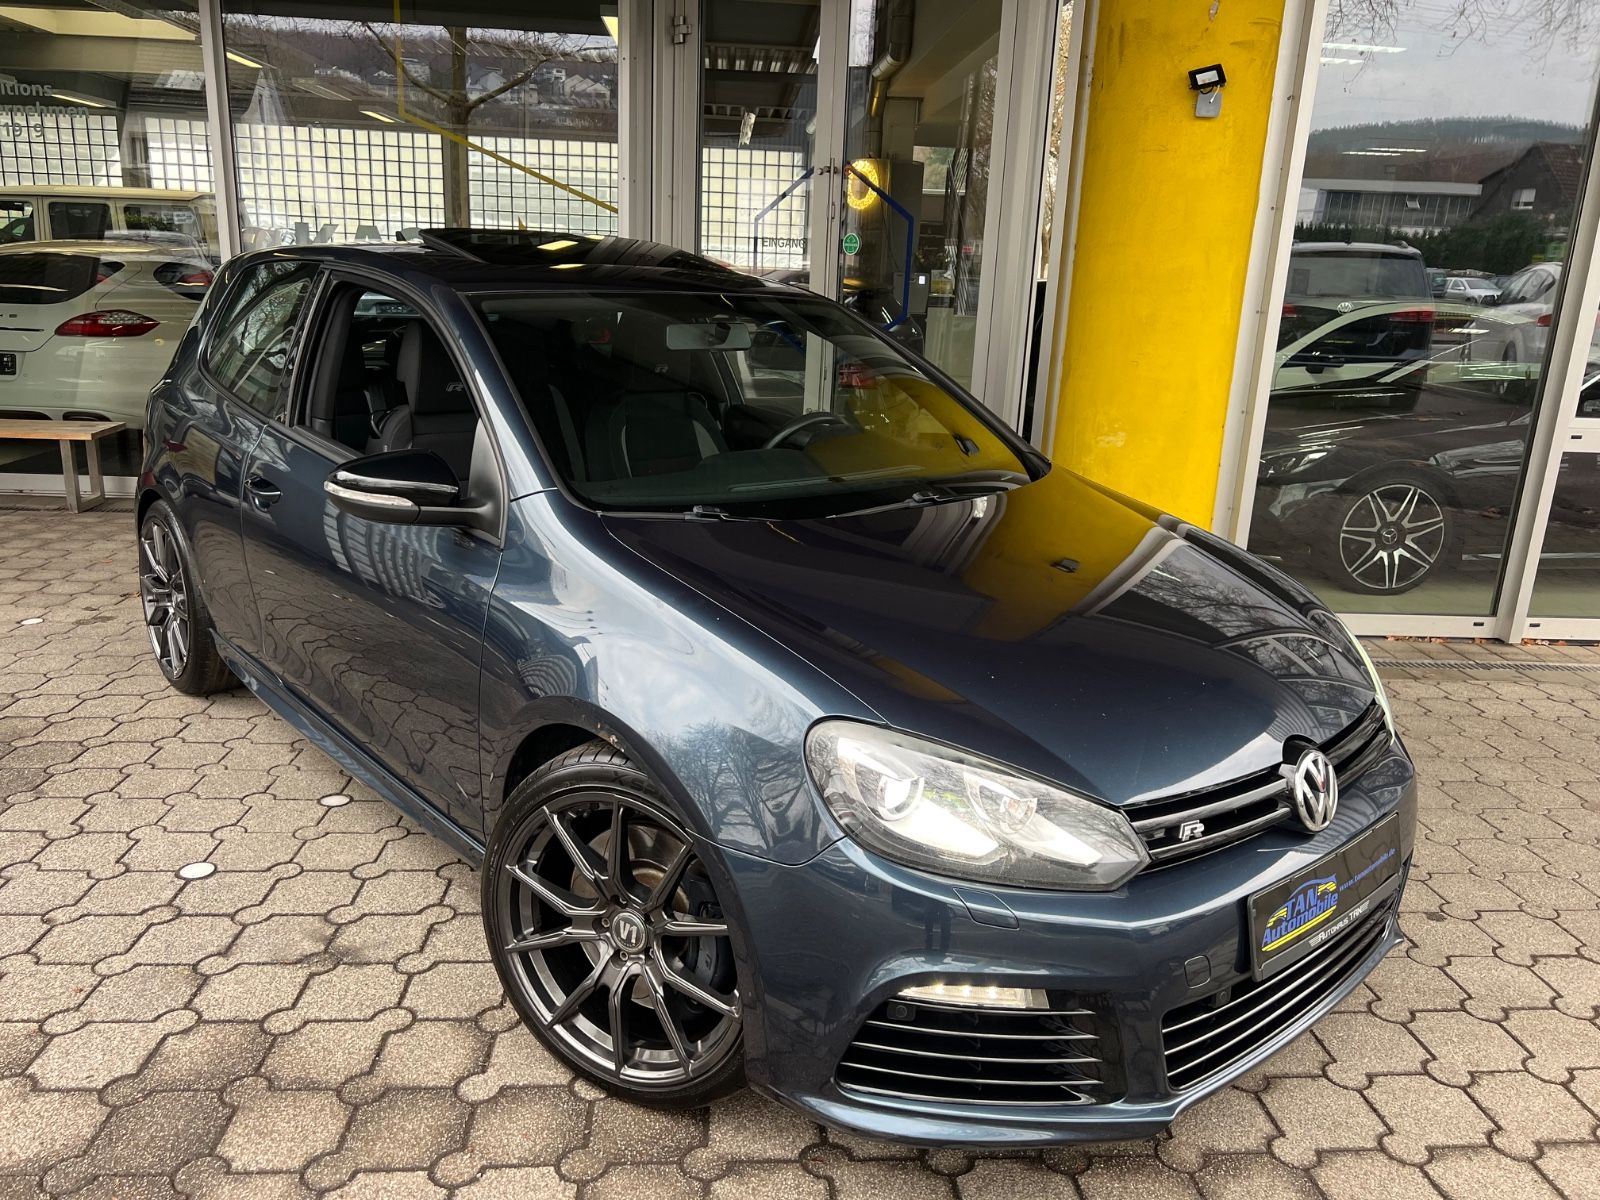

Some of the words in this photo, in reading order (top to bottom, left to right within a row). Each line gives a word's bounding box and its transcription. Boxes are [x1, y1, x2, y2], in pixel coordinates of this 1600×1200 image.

[1179, 820, 1205, 842] R
[1262, 892, 1338, 947] Automobile
[1285, 886, 1318, 920] TAN
